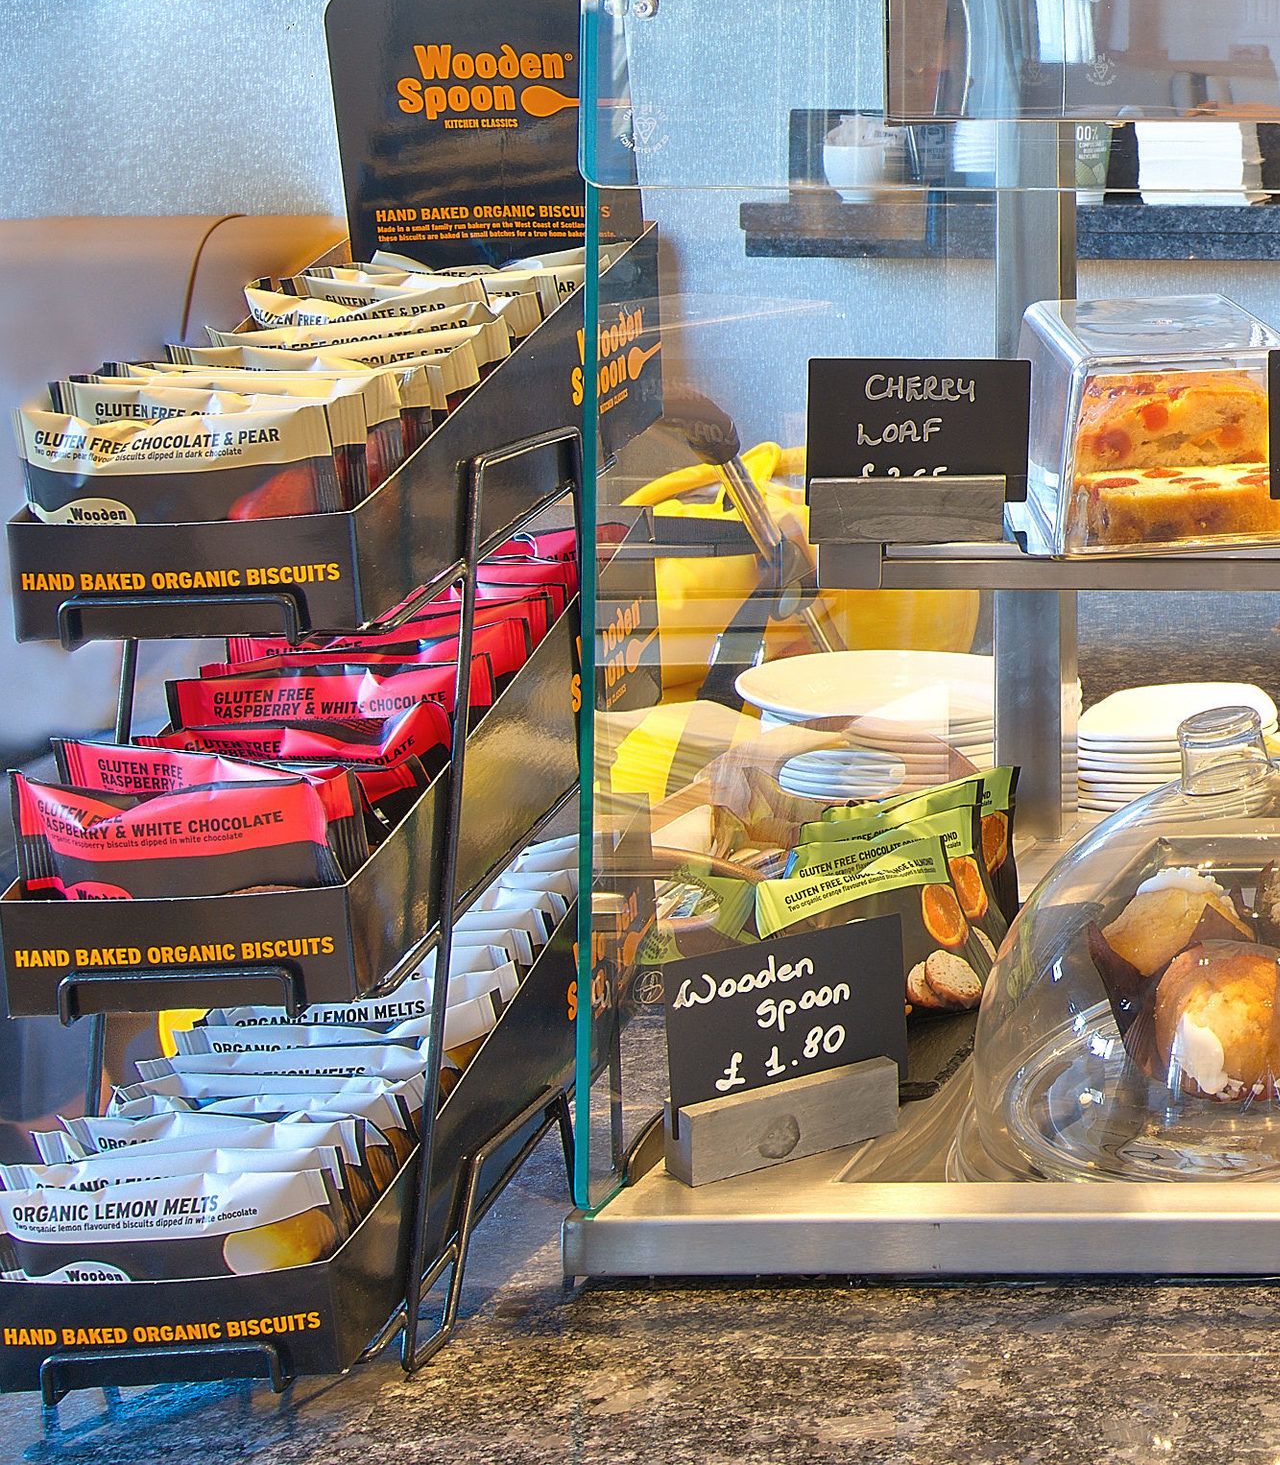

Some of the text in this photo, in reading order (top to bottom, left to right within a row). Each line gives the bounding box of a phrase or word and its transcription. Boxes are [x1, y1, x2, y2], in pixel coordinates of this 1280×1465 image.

[412, 44, 565, 80] Wooden
[397, 77, 516, 120] Spoon
[444, 118, 518, 129] KITCHEN CLASSICS
[376, 205, 611, 223] HAND BAKED ORGANIC BISCUIS
[864, 374, 977, 402] CHERRY
[34, 428, 280, 455] GLUTEN FREE CHOCOLATE & PEAR
[857, 418, 943, 447] LOAF
[22, 562, 341, 591] HAND BAKED ORGANIC BISCUITS
[213, 687, 316, 706] GLUTEN FREE
[213, 703, 300, 719] RASPBERRY
[304, 702, 316, 716] &
[320, 699, 366, 716] WHITE
[115, 824, 126, 838] &
[132, 820, 183, 837] WHITE
[188, 811, 284, 834] CHOCOLATE
[799, 861, 833, 879] GLUTEN
[834, 854, 857, 868] FREE
[784, 878, 843, 905] GLUTEN FREE
[15, 937, 334, 968] HAND BAKED ORGANIC BISCUITS
[673, 954, 814, 1011] Wooden
[755, 981, 851, 1035] Spoon
[715, 1024, 846, 1093] £ 1.80
[12, 1195, 219, 1223] ORGANIC LEMON MELTS
[29, 1223, 57, 1234] organic
[58, 1221, 82, 1232] lemon
[84, 1220, 121, 1231] flavoured
[123, 1218, 153, 1229] biscuits
[155, 1217, 183, 1229] dipped
[185, 1216, 193, 1226] in
[217, 1207, 258, 1221] chocolate
[4, 1312, 321, 1346] HAND BAKED ORGANIC BISCUITS
